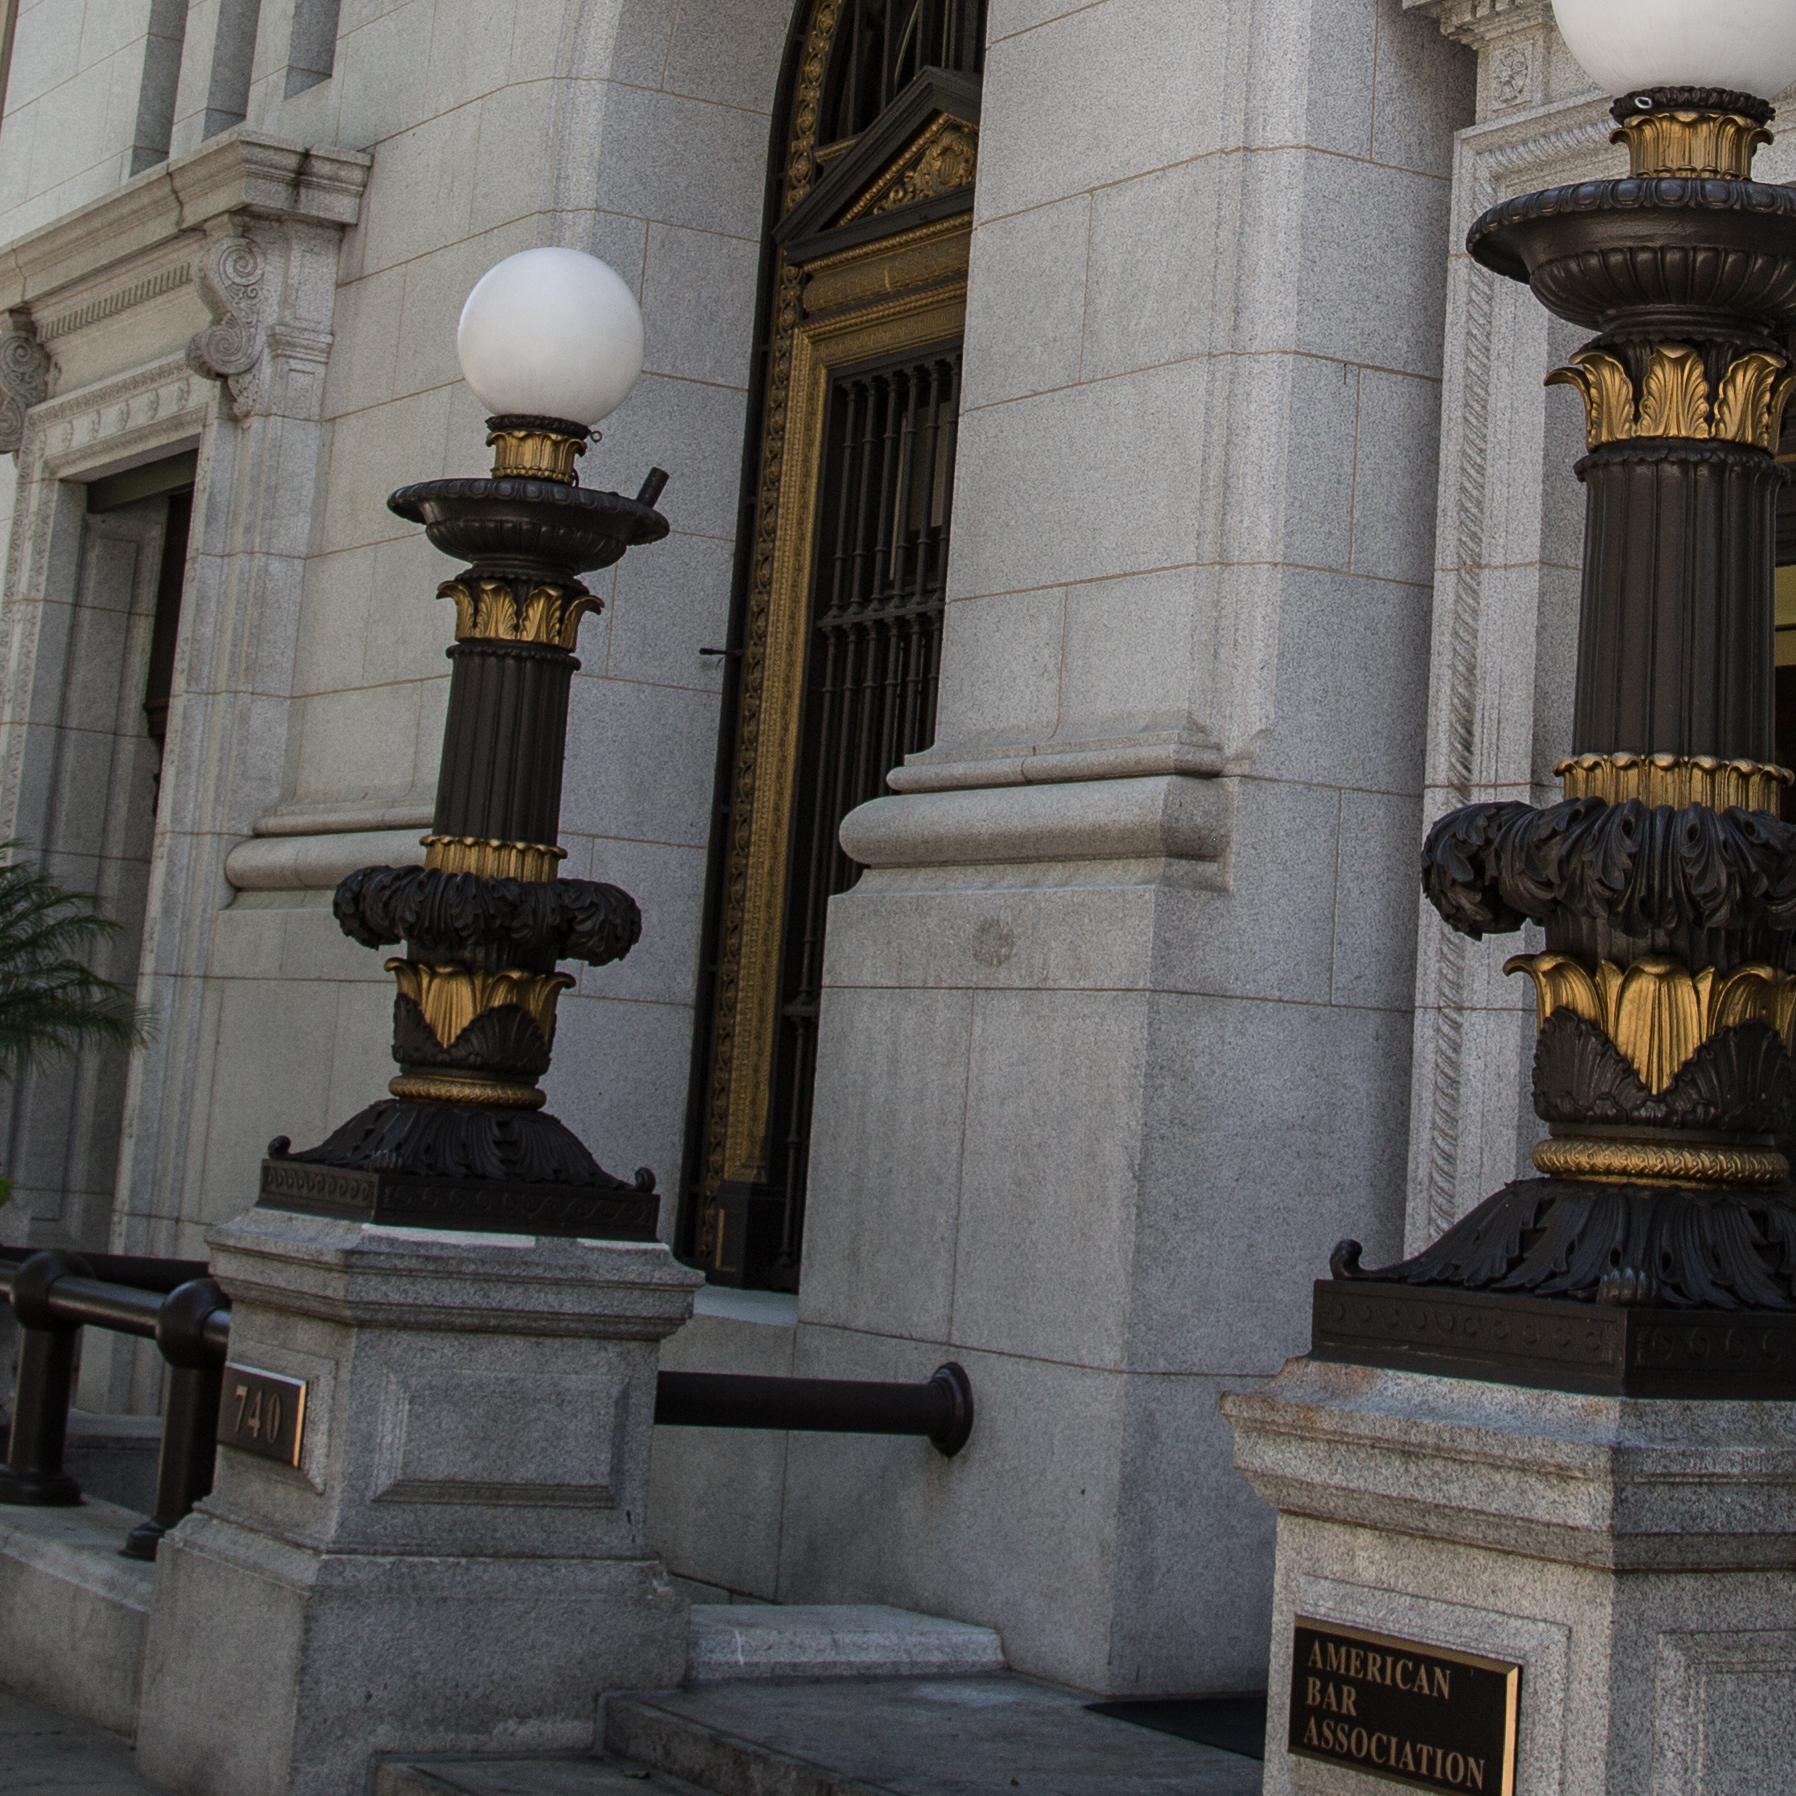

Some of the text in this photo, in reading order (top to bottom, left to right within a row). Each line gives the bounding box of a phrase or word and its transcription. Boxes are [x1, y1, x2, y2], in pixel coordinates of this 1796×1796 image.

[235, 1384, 281, 1444] 740
[1306, 1677, 1358, 1717] BAR
[1307, 1638, 1452, 1700] AMERICAN
[1303, 1715, 1486, 1791] ASSOCIATION
